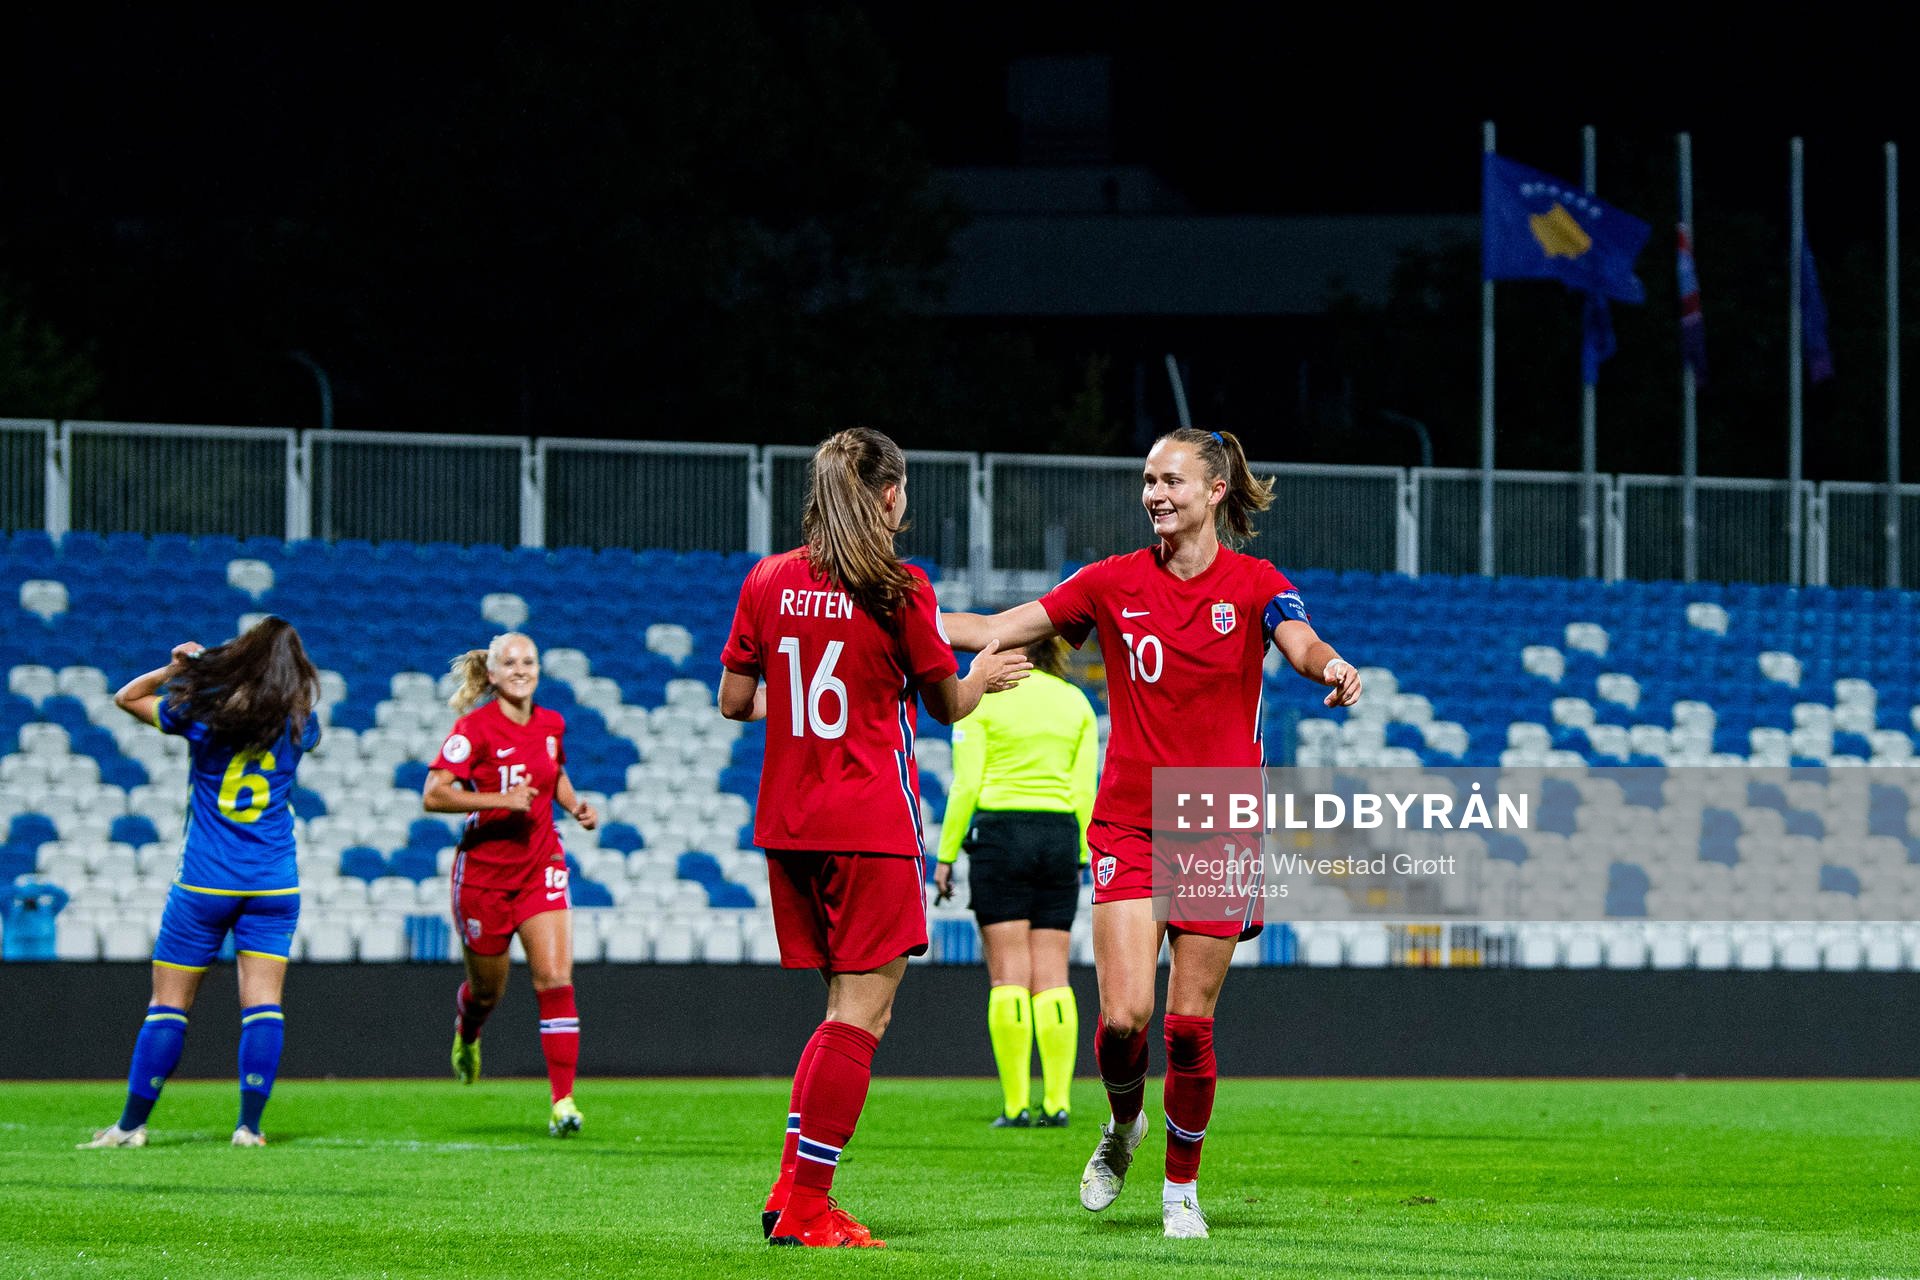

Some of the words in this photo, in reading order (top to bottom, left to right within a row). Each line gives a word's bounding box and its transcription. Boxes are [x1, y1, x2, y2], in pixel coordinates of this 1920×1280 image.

[780, 589, 854, 620] REITEN
[1122, 632, 1164, 684] 10
[777, 637, 849, 739] 16
[218, 750, 277, 823] 6
[498, 764, 526, 795] 15
